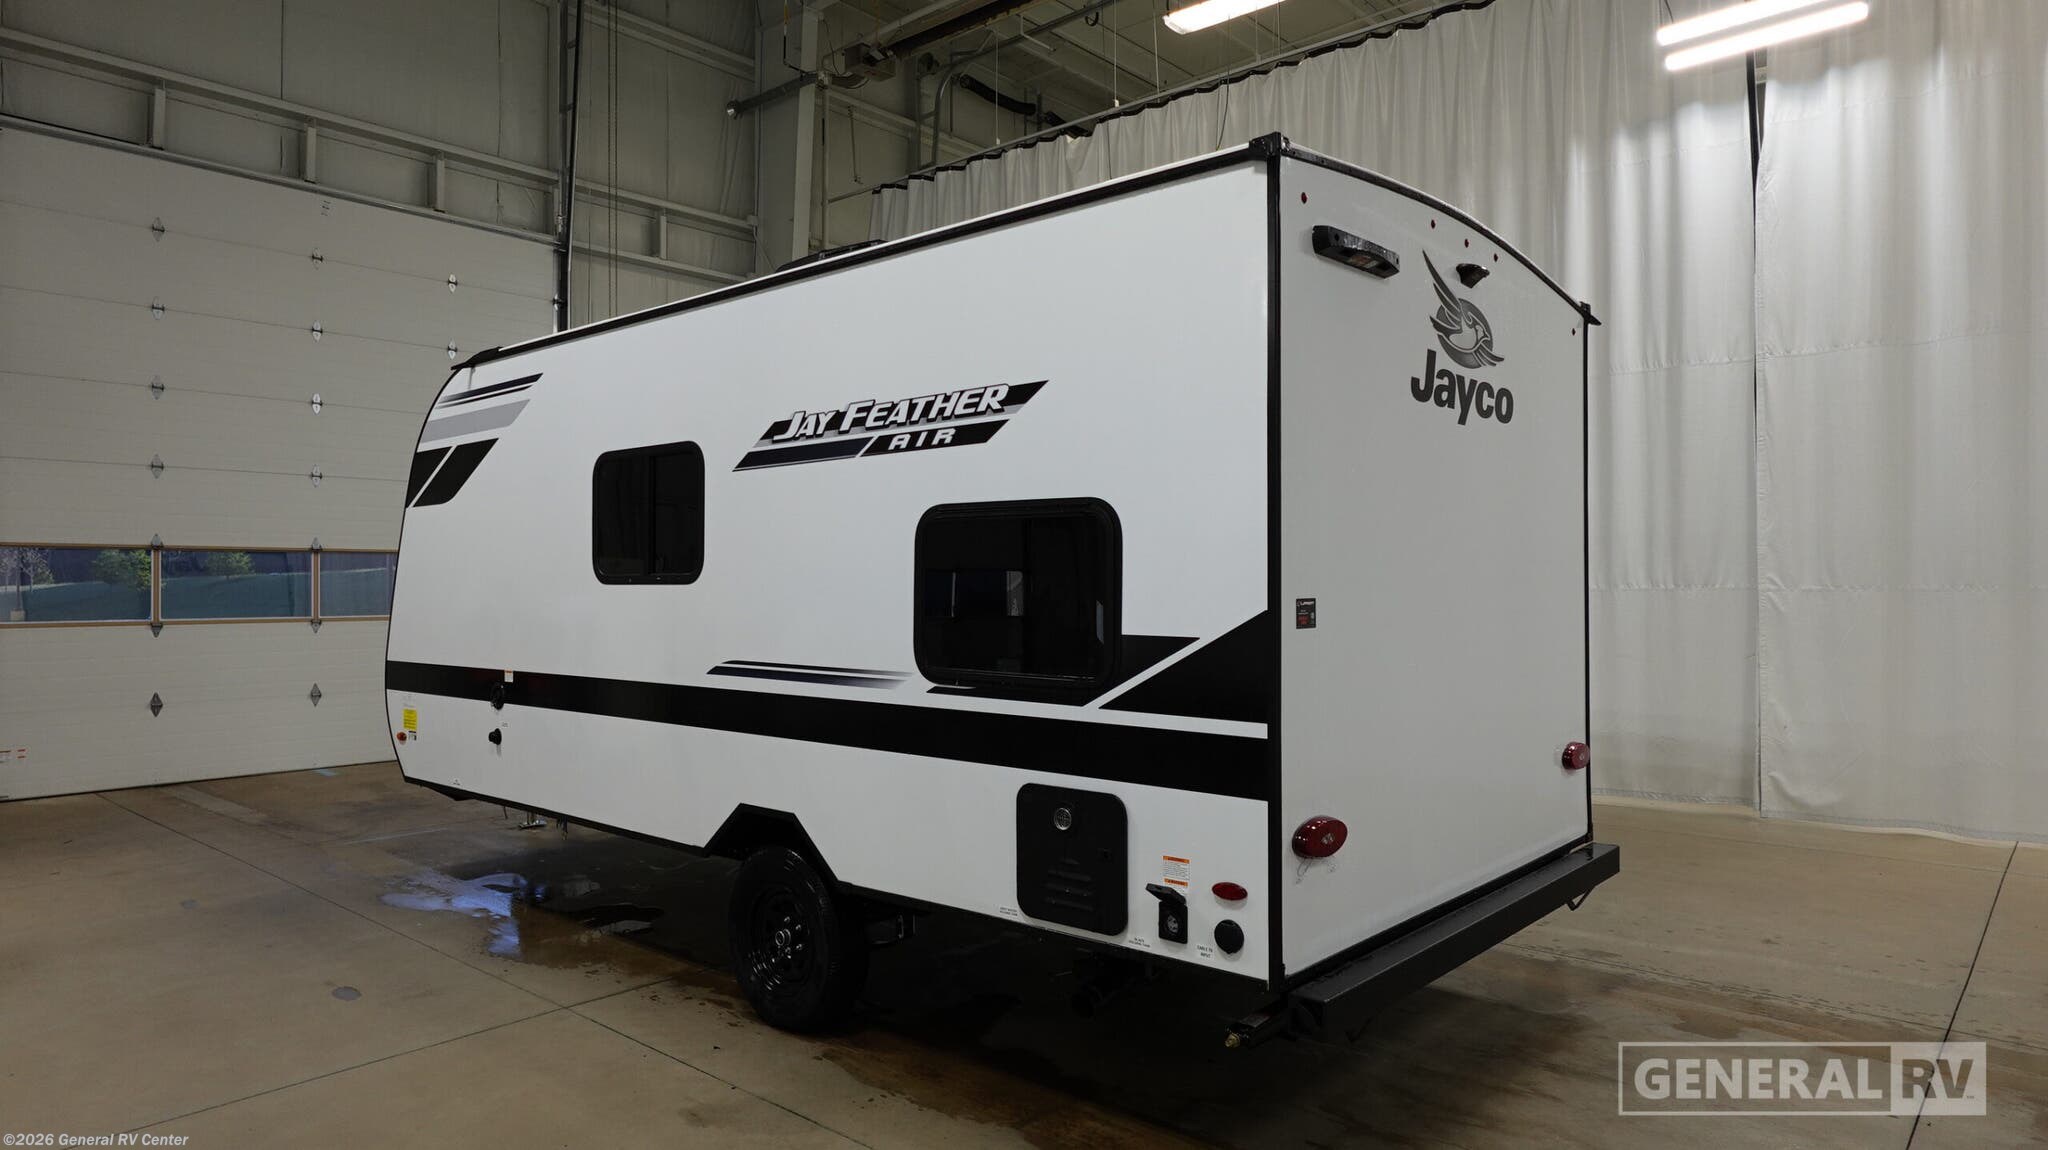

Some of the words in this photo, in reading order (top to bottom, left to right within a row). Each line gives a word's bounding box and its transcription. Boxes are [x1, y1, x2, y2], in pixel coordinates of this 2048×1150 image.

[773, 410, 838, 443] JAY
[838, 383, 1010, 434] FEATHER
[1411, 349, 1514, 426] Jayco
[888, 428, 956, 451] AIR
